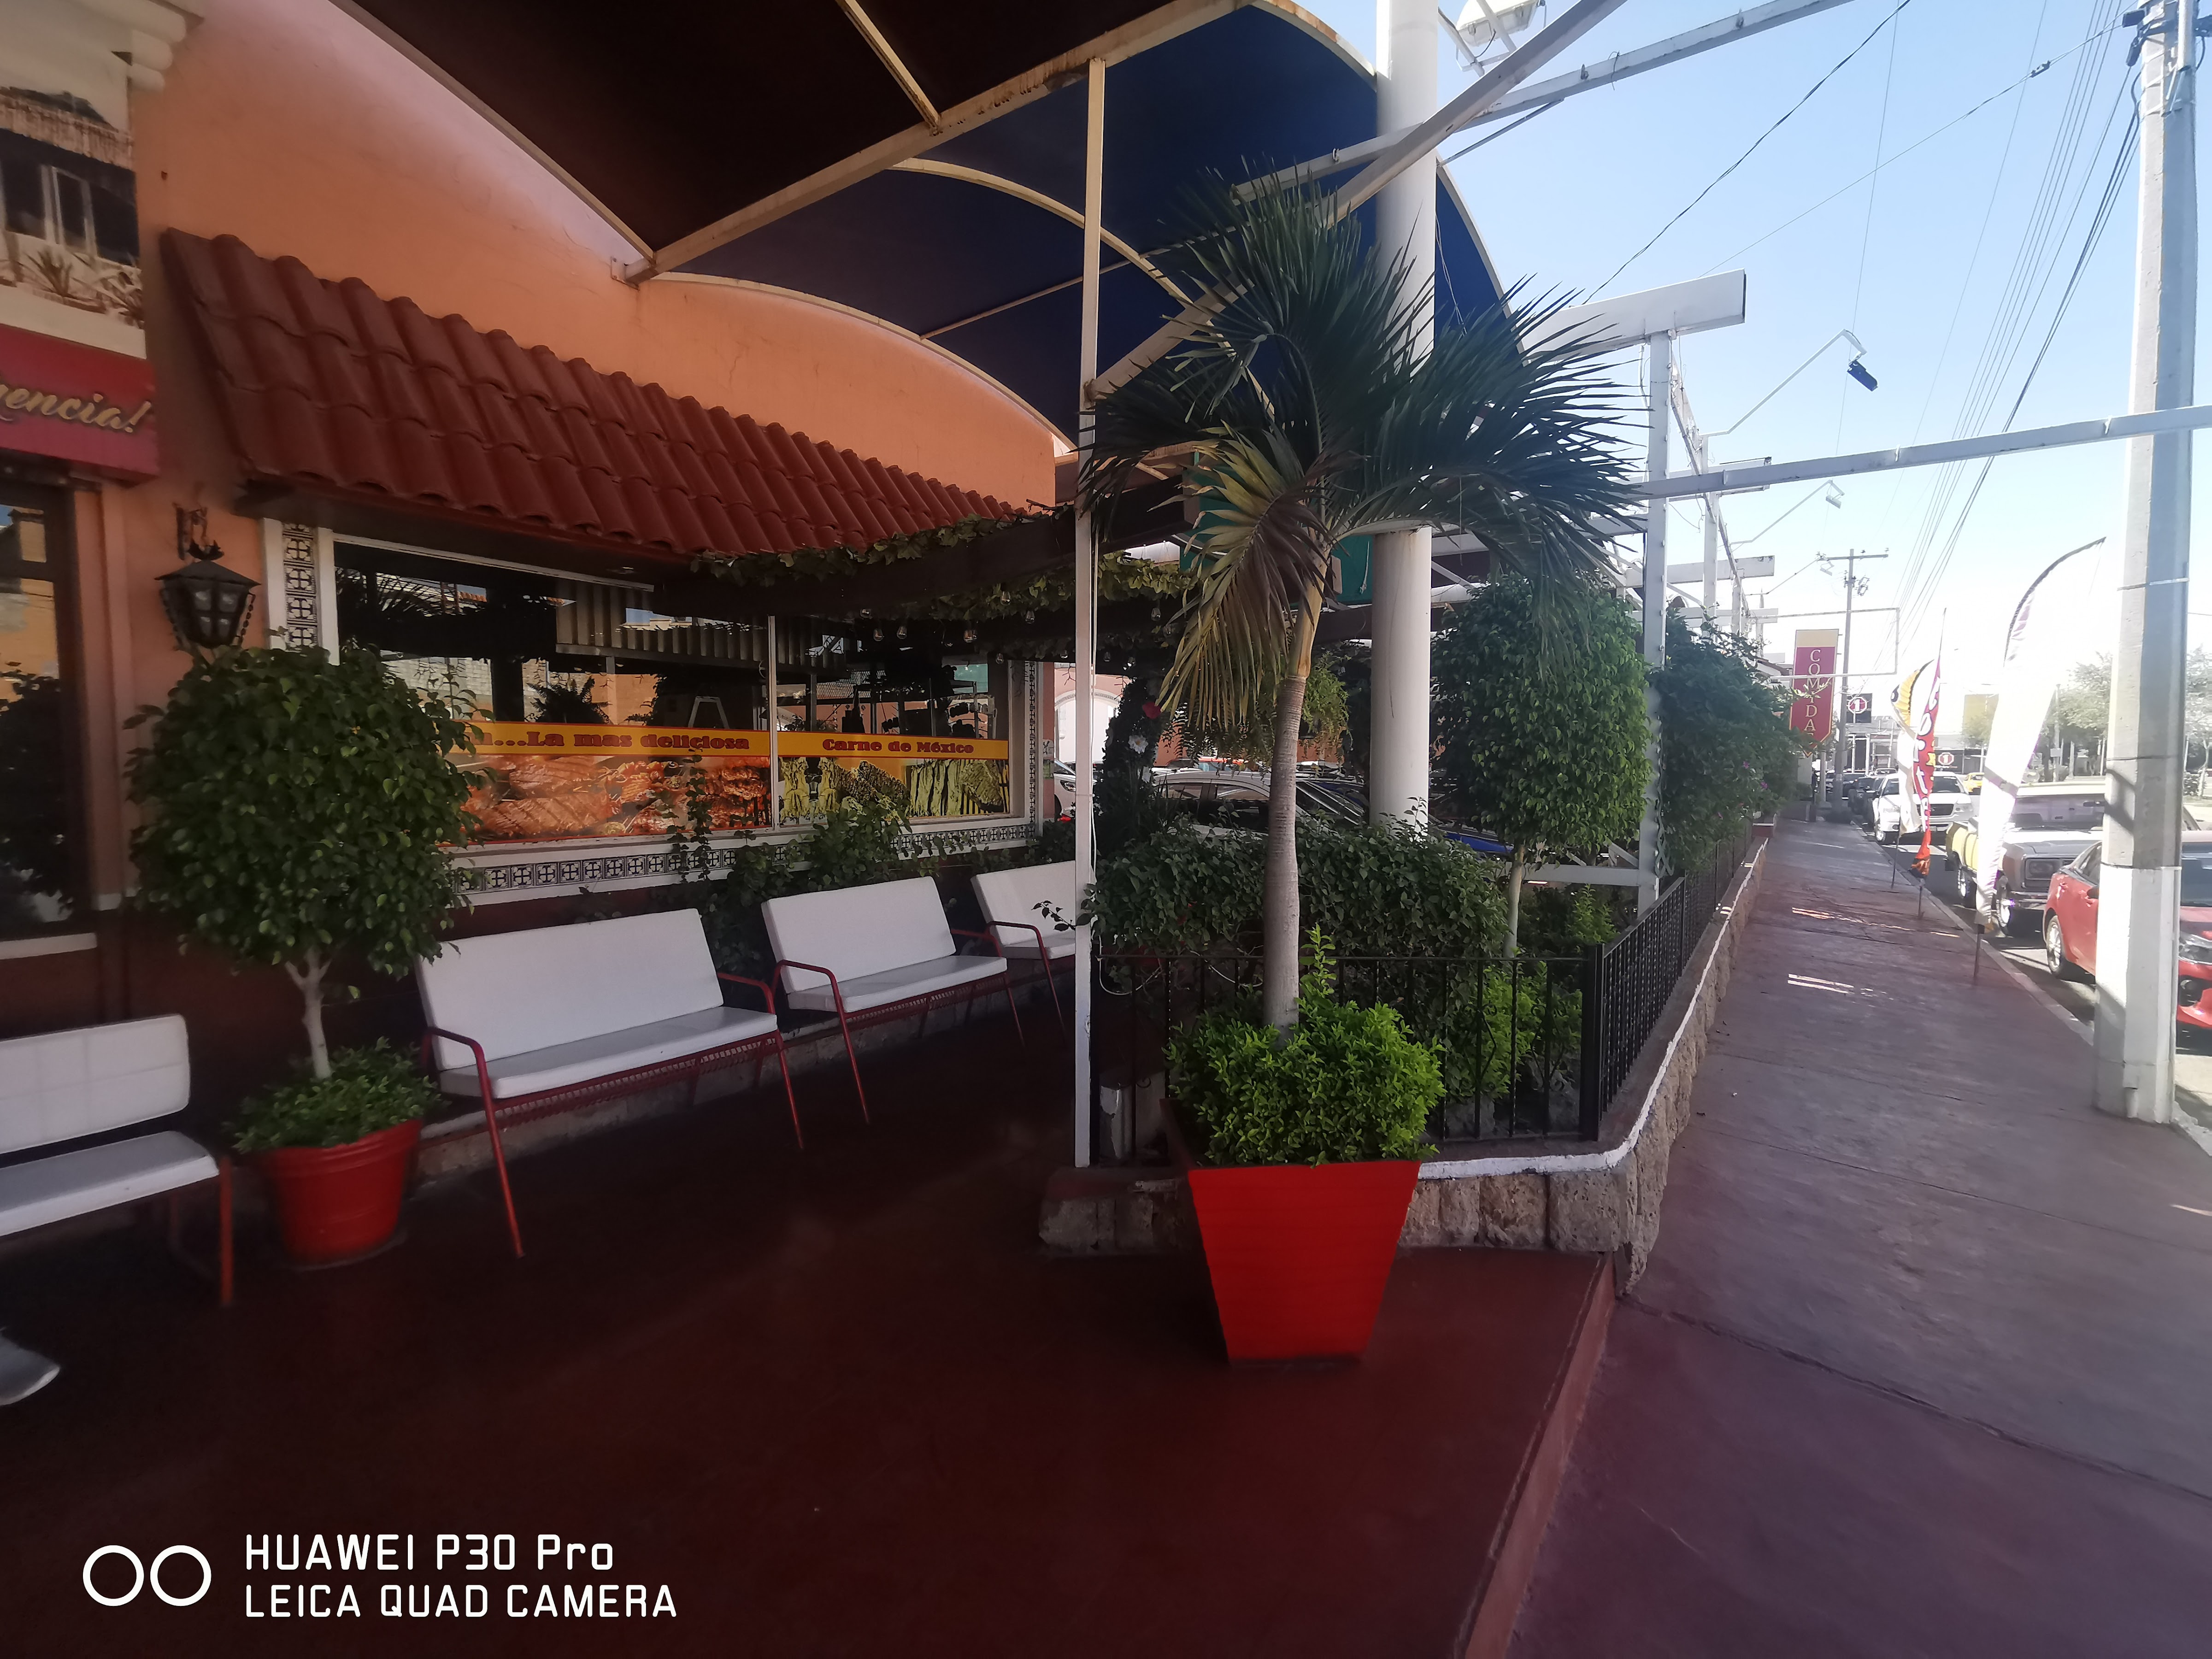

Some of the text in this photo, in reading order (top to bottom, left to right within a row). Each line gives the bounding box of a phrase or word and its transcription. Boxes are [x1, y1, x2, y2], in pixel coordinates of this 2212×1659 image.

[0, 384, 152, 433] encia!
[1804, 649, 1821, 736] COMIDA
[574, 734, 633, 747] mas
[641, 735, 750, 749] deliciosa
[823, 739, 974, 753] Carne de México
